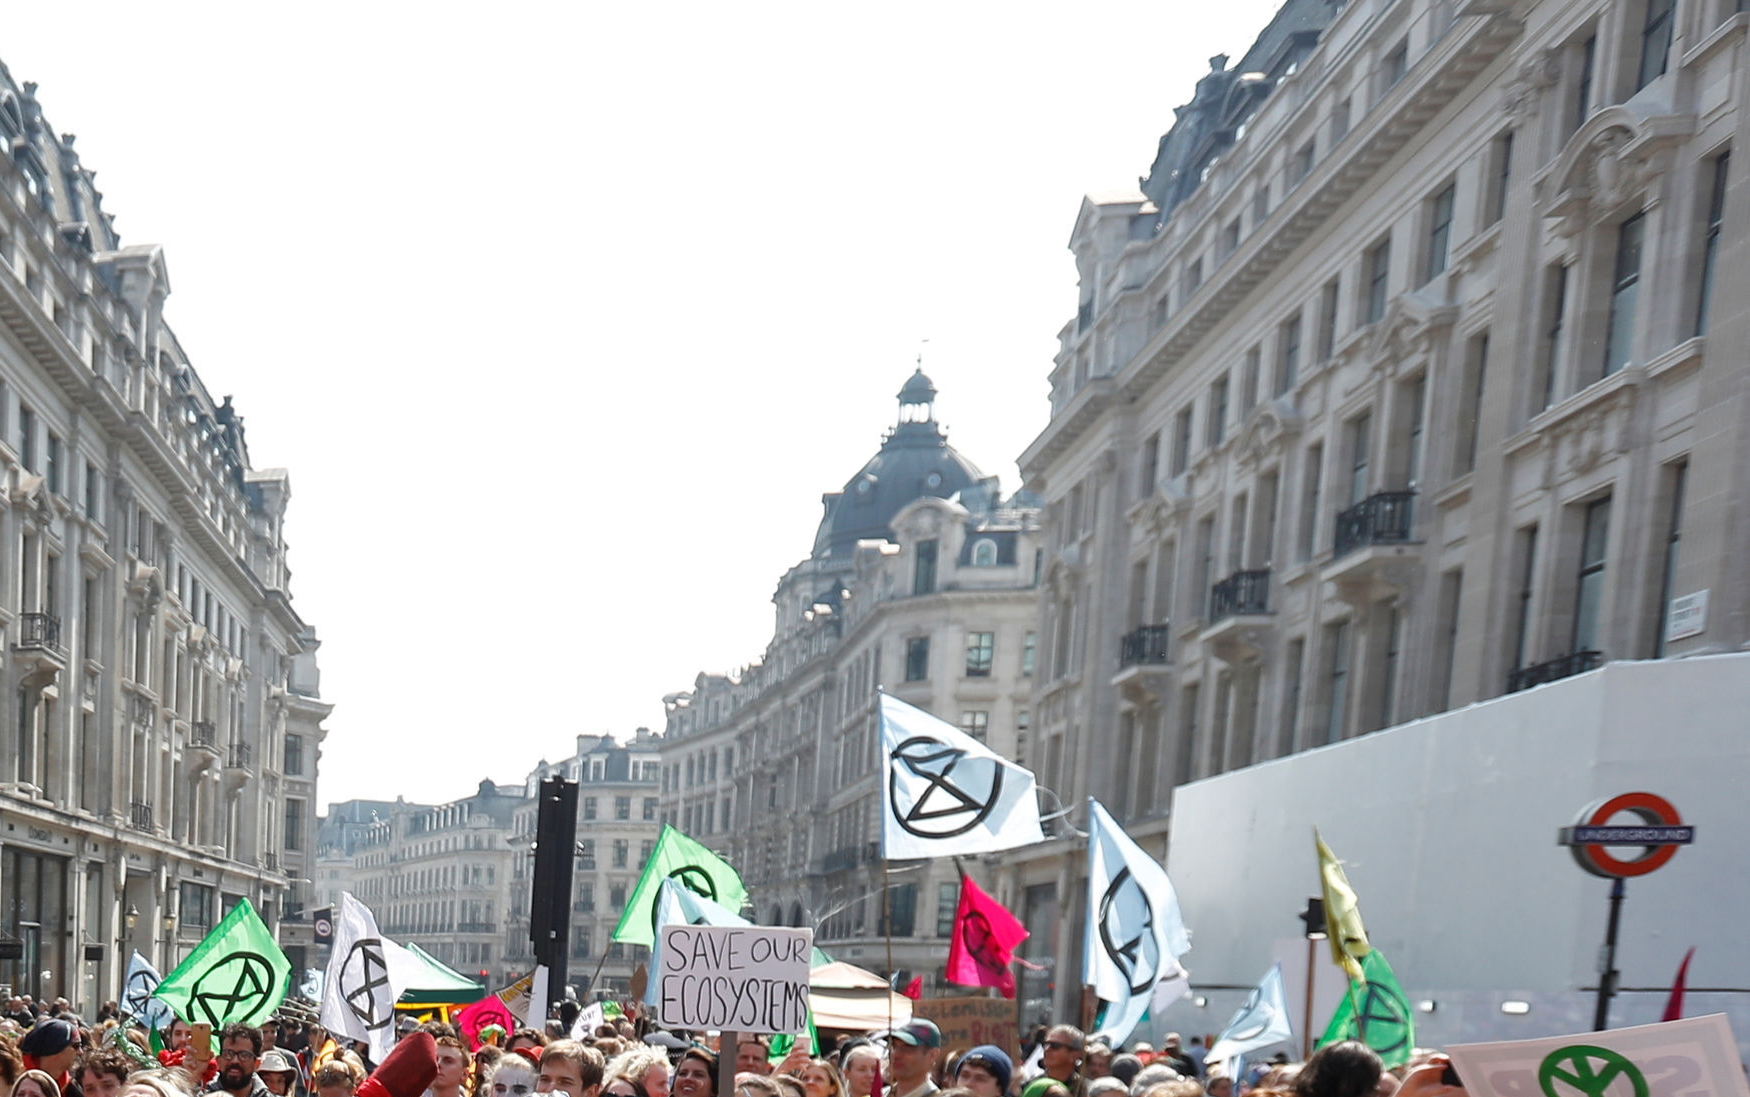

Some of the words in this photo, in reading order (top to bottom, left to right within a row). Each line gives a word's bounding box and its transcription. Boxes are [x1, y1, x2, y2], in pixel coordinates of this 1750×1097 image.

[666, 930, 746, 972] SAVE
[751, 937, 808, 965] OUR
[662, 974, 810, 1031] ECOSYSTEMS
